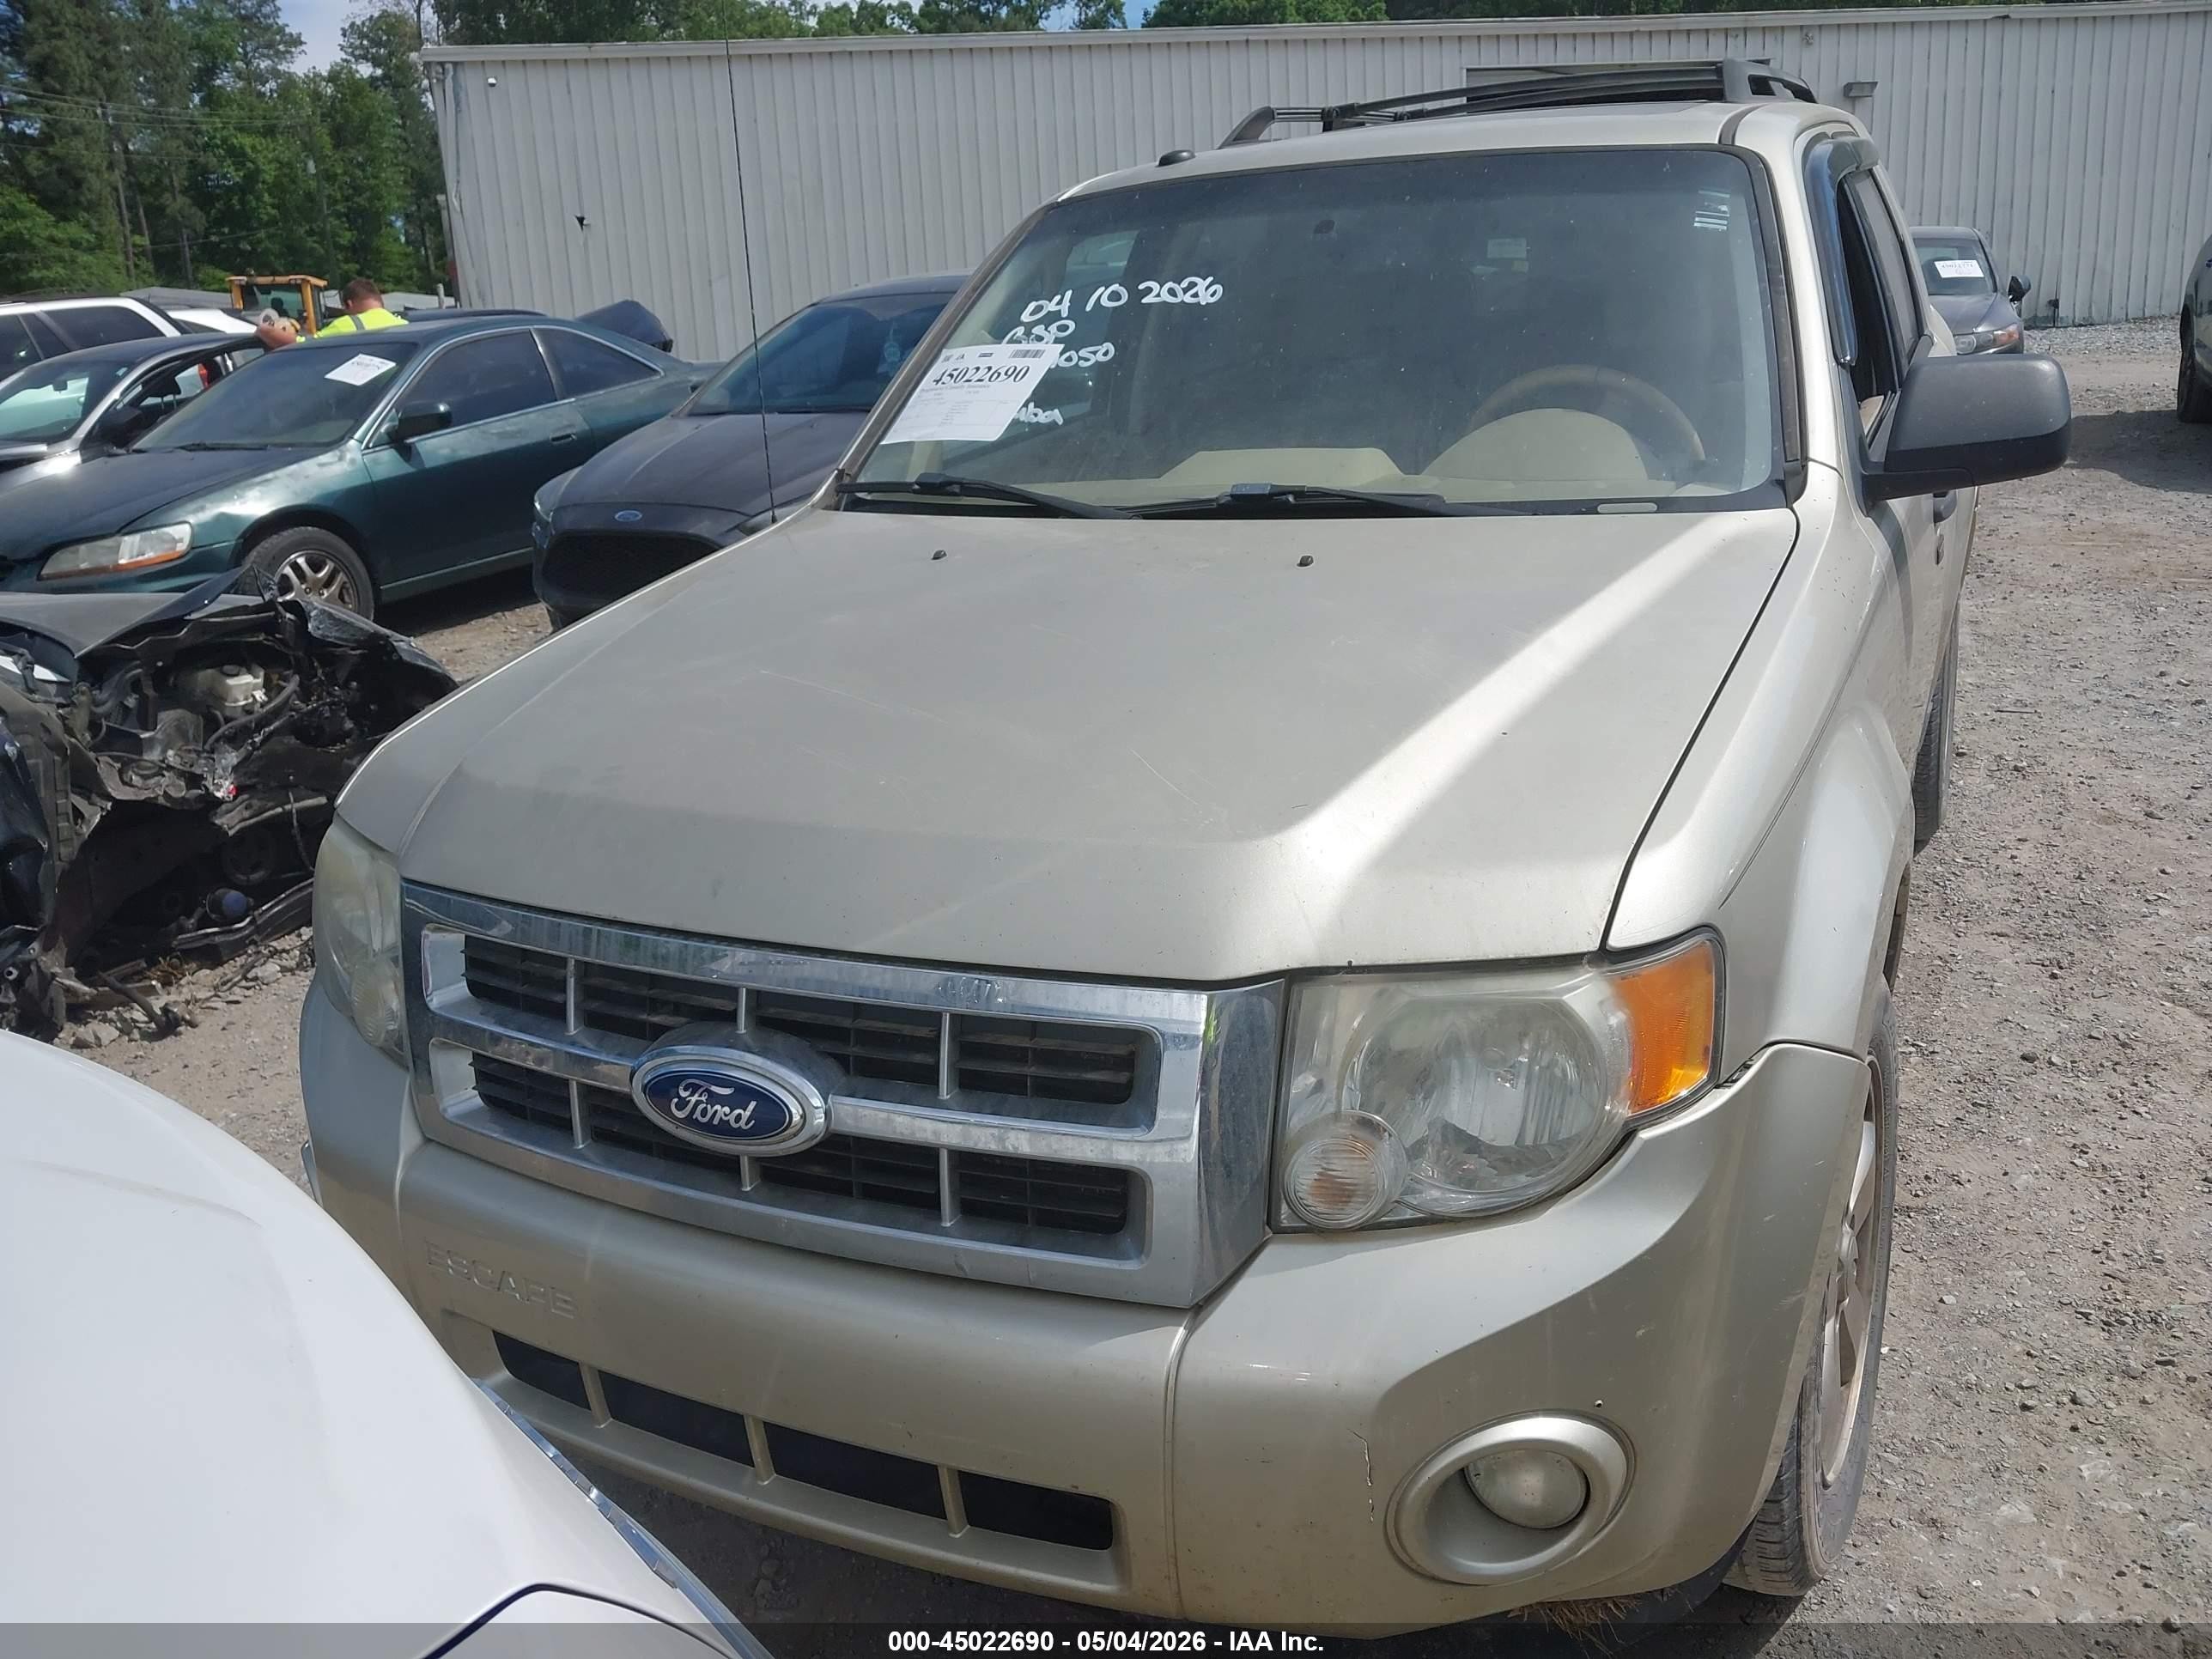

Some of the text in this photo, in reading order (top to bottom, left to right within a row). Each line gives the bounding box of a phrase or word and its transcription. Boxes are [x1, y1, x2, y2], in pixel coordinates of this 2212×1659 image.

[1020, 276, 1223, 322] 04 10 2026
[933, 365, 1030, 386] 45022690
[671, 1079, 757, 1130] Ford
[426, 1241, 576, 1319] ESCAPE
